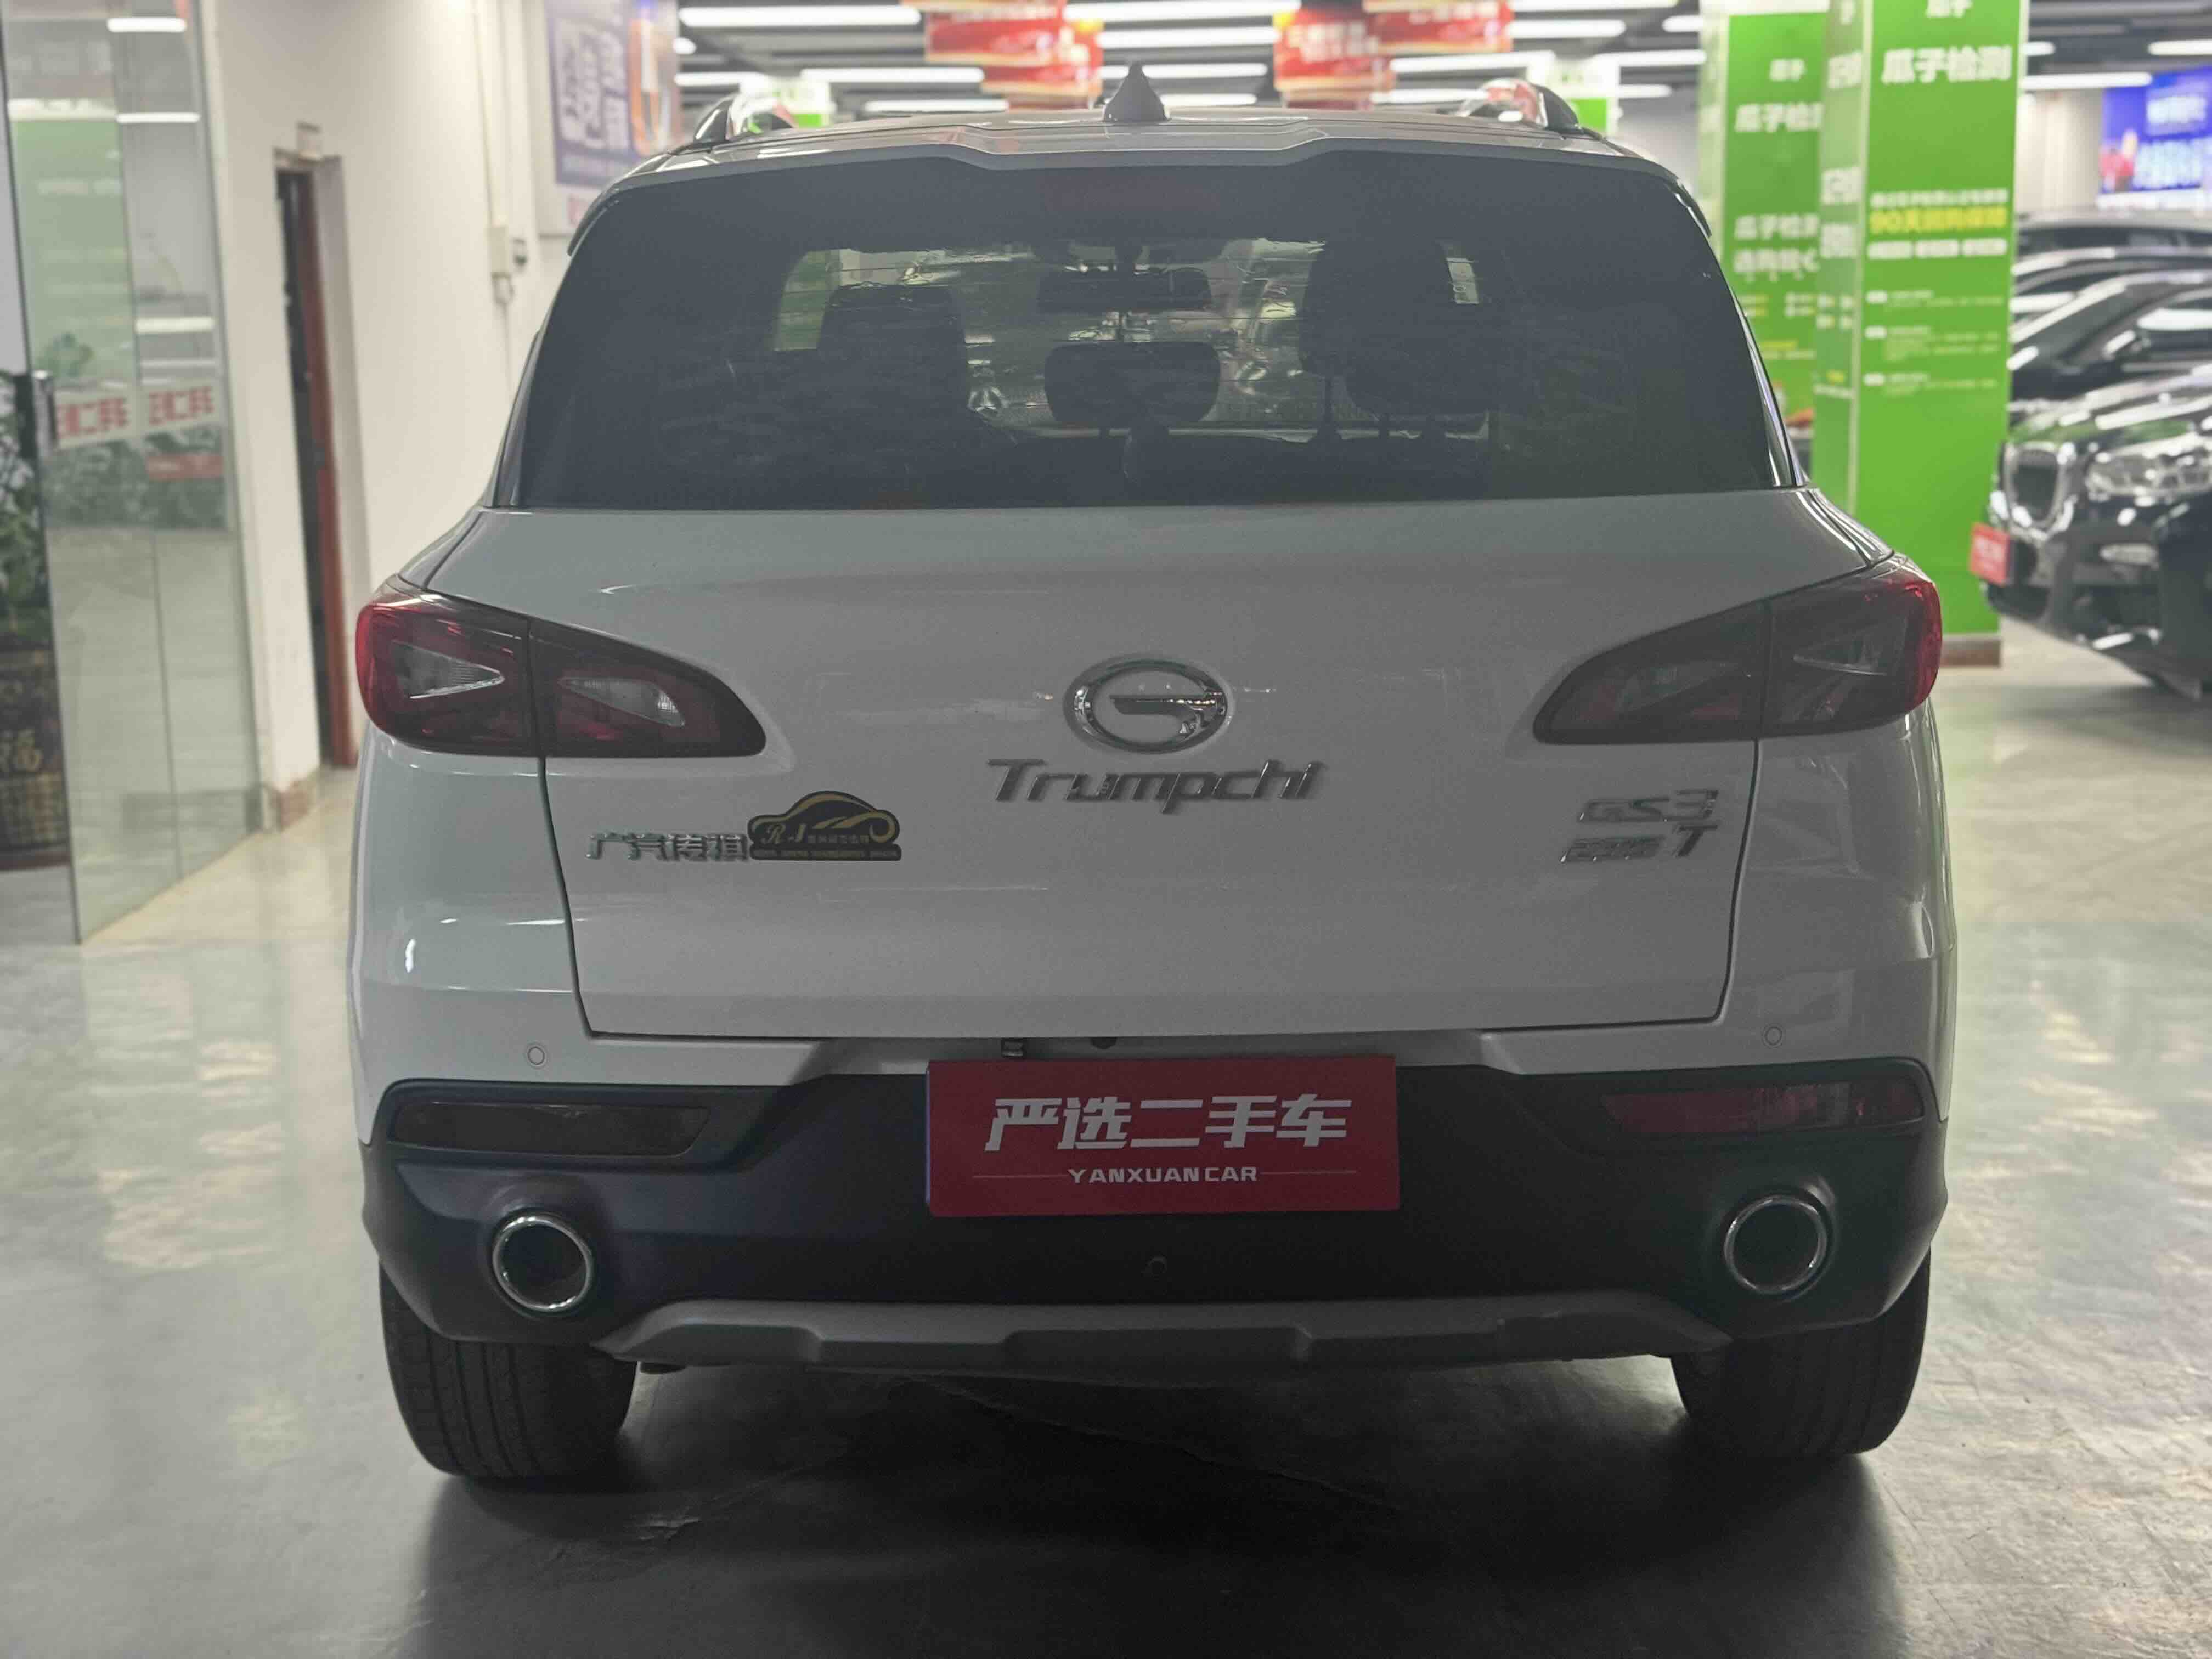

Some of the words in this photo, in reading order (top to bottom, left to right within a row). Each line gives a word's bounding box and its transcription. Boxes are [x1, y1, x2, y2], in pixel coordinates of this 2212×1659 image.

[988, 759, 1324, 815] Trumpchi
[1577, 789, 1719, 823] GS3
[985, 1093, 1352, 1152] 严选二手车
